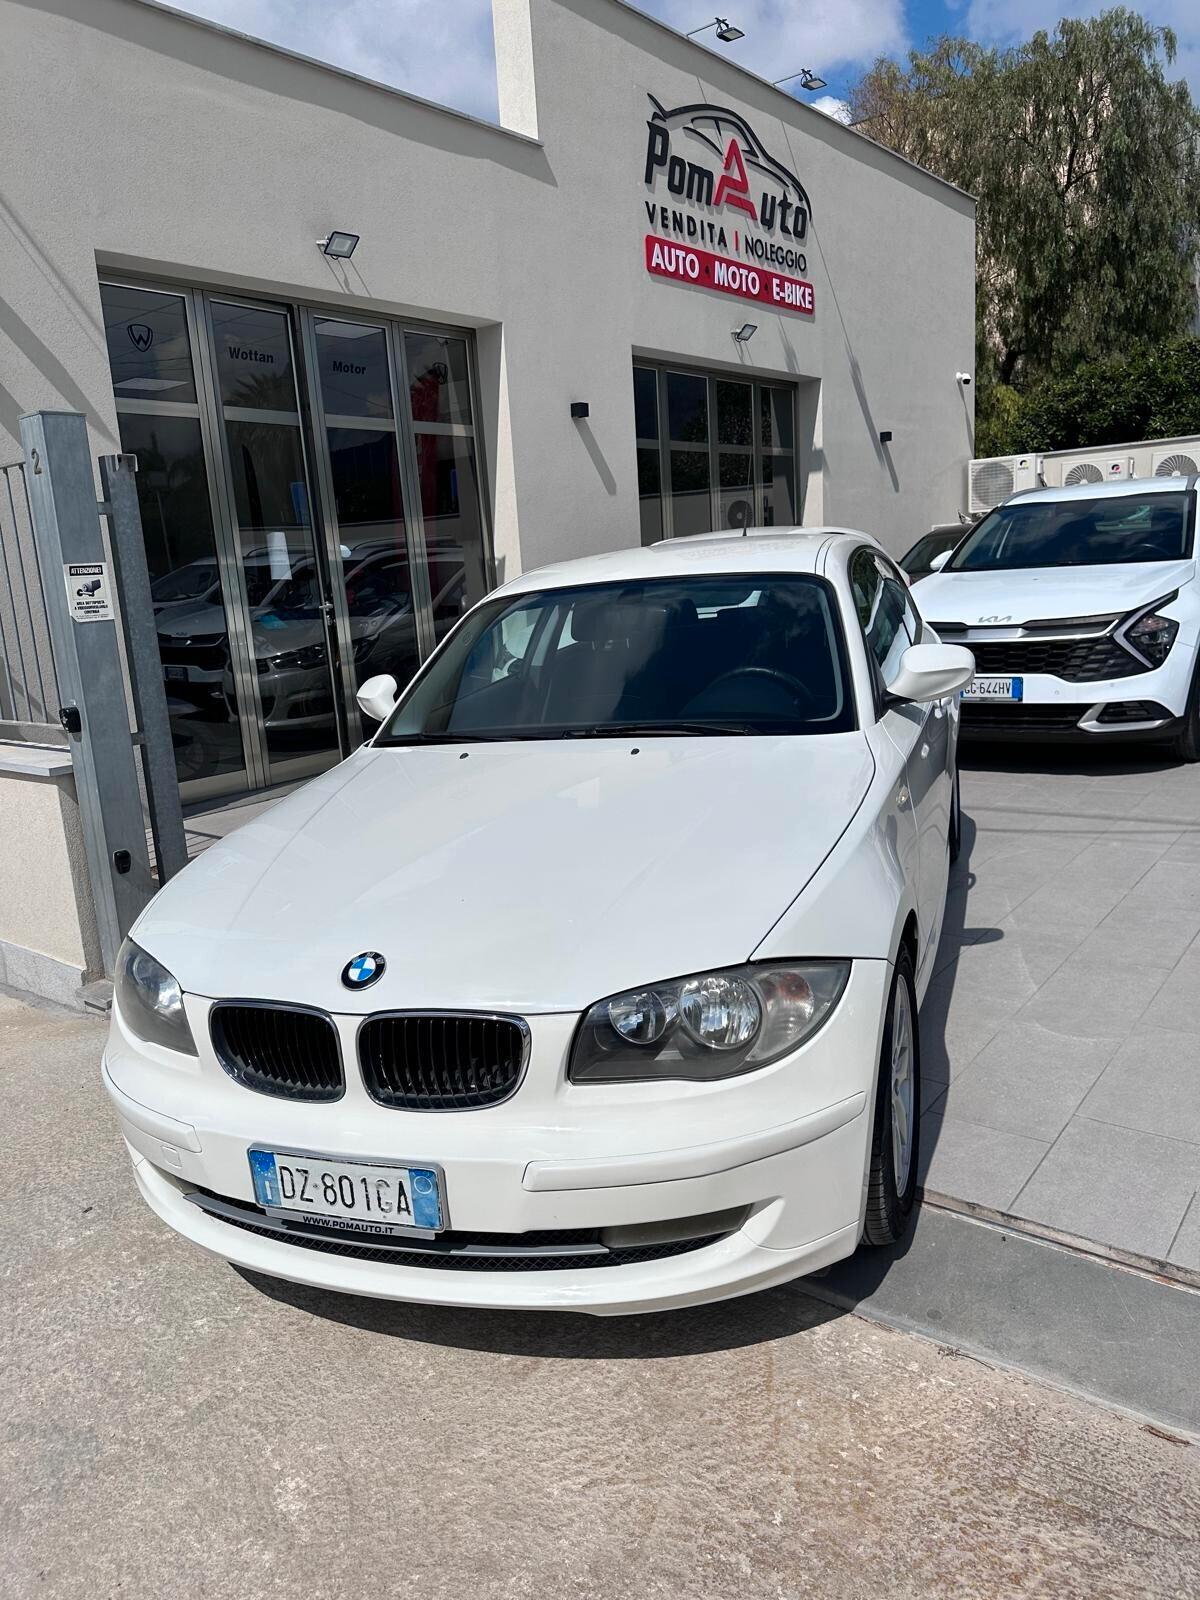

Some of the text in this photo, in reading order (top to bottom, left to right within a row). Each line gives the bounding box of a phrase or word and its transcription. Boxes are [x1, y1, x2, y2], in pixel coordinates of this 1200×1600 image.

[645, 201, 807, 272] VENDITA NOLEGGIO
[651, 243, 813, 309] AUTO MOTO E-BIKE
[228, 346, 367, 375] Wottan Motor
[31, 448, 43, 475] 2
[302, 1215, 394, 1235] WWW.POMAUTO.IT
